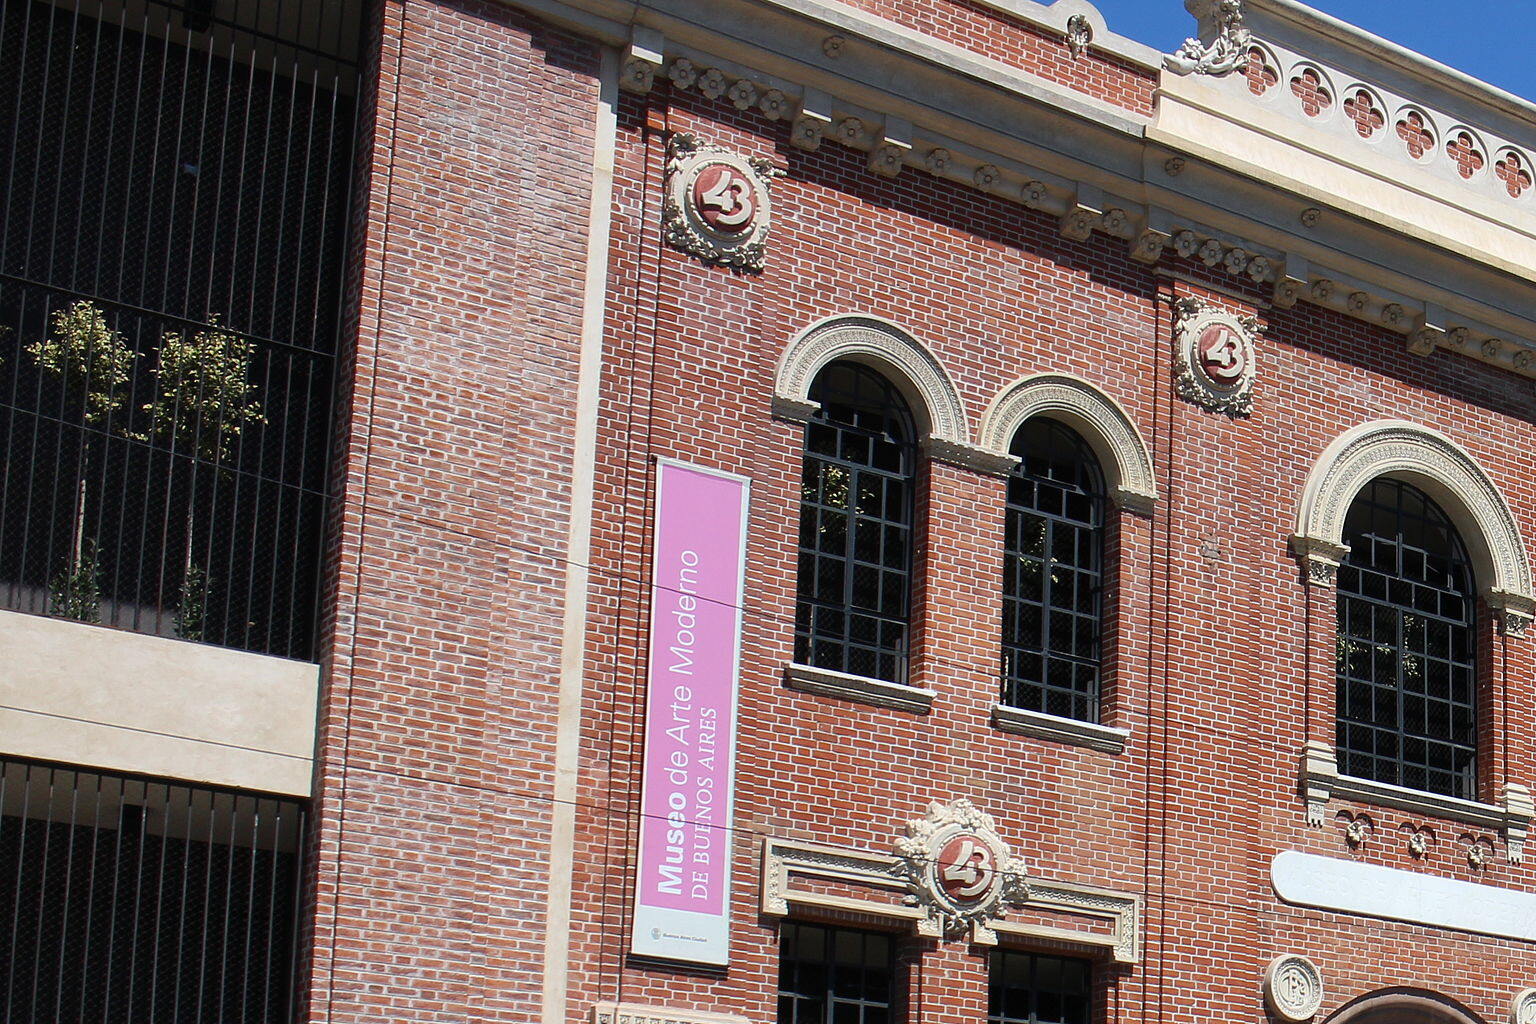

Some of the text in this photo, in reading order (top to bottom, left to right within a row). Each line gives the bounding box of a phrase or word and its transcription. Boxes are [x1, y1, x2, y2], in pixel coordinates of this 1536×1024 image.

[701, 170, 752, 225] 43
[1206, 329, 1245, 377] 43
[657, 550, 698, 895] Museo de Arte Moderno
[691, 707, 717, 900] DE BUENOS AIRES
[943, 841, 992, 897] 43
